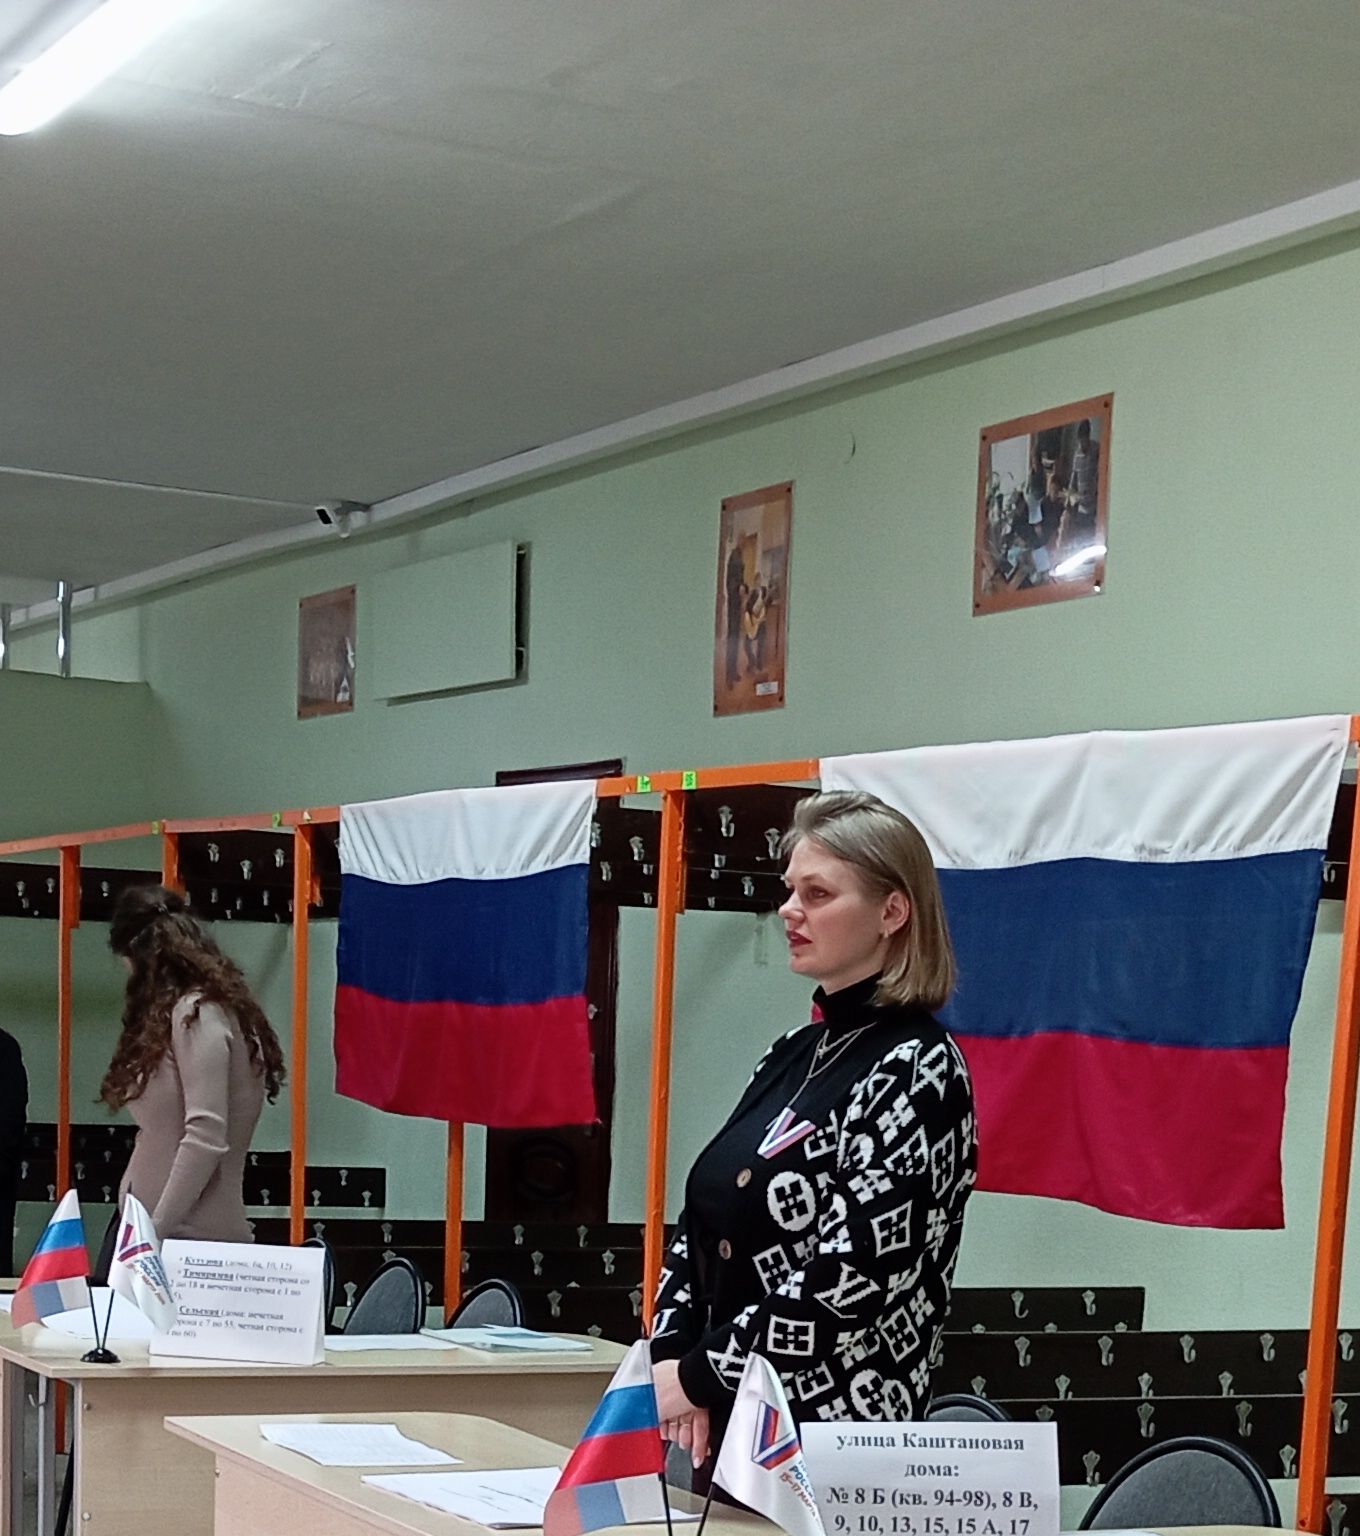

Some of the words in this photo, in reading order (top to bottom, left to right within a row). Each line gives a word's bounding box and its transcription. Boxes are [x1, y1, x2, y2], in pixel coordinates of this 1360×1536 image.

[267, 1276, 299, 1285] сторона
[206, 1284, 242, 1292] нечетная
[243, 1287, 276, 1295] сторона
[179, 1305, 221, 1317] Сельская
[247, 1312, 284, 1320] нечетная
[238, 1323, 264, 1331] четная
[265, 1325, 297, 1334] сторона
[836, 1435, 896, 1451] улица
[902, 1432, 1025, 1451] Каштановая
[903, 1463, 960, 1478] дома:
[826, 1487, 850, 1504] №
[854, 1487, 866, 1505] 8
[872, 1488, 886, 1505] Б
[891, 1488, 928, 1509] (кв.
[933, 1489, 997, 1511] 94-98),
[1001, 1490, 1013, 1508] 8
[1019, 1491, 1039, 1511] В,
[834, 1514, 852, 1536] 9,
[858, 1515, 884, 1536] 10,
[891, 1516, 917, 1536] 13,
[956, 1517, 977, 1535] 15
[1009, 1518, 1030, 1536] 17
